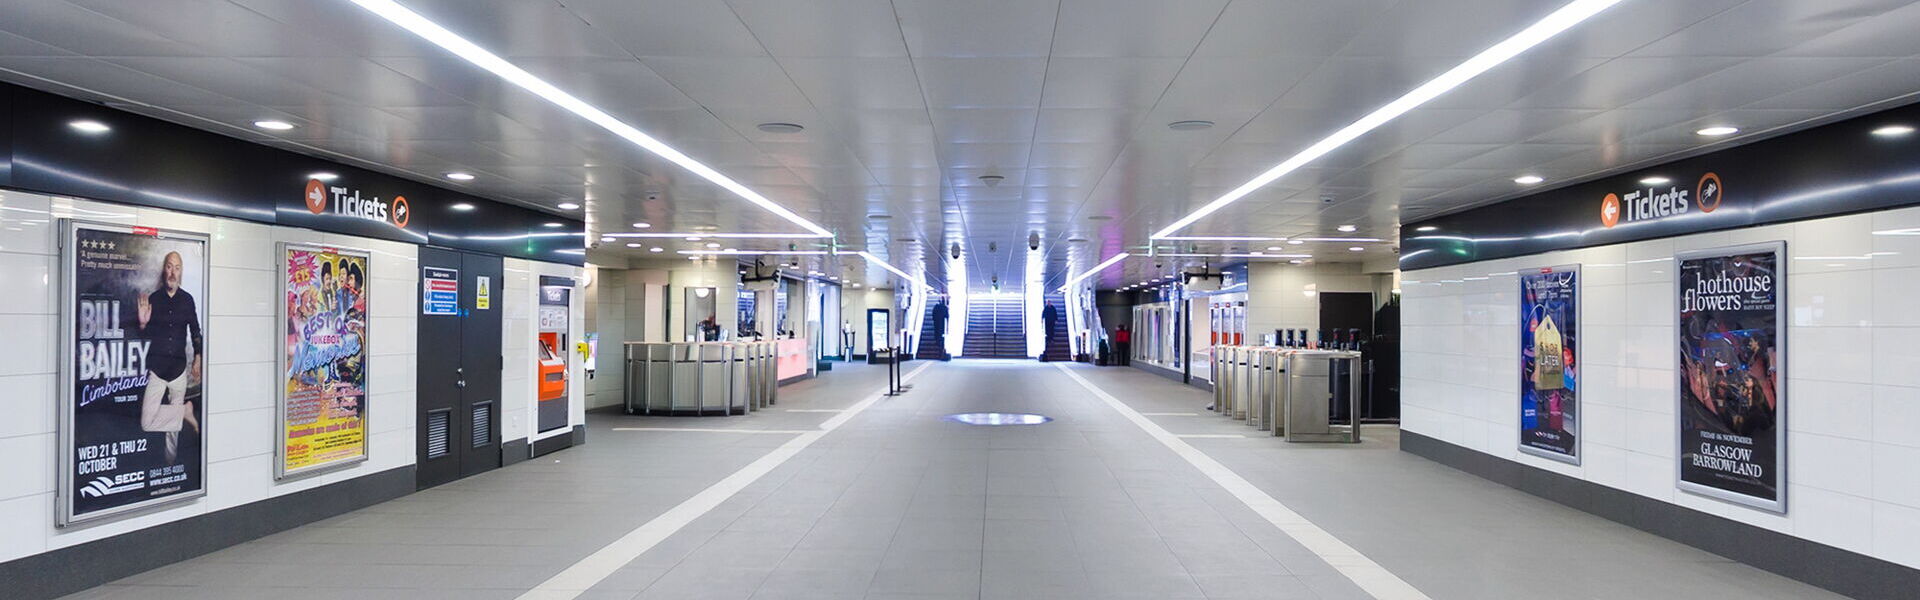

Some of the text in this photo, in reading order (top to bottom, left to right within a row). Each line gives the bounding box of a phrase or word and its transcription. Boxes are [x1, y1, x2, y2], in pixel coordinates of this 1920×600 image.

[331, 186, 387, 222] Tickets
[1624, 187, 1688, 221] Tickets
[1696, 269, 1771, 295] hothouse
[1681, 288, 1741, 313] flowers
[80, 300, 125, 339] BILL
[304, 311, 333, 341] BEST
[80, 339, 151, 380] BAILEY
[80, 370, 149, 407] Limboland
[78, 438, 148, 461] WED 21 & THU 22
[1701, 442, 1752, 462] GLASGOW
[1722, 434, 1753, 445] NOVEMBER
[78, 457, 118, 475] OCTOBER
[114, 471, 145, 485] SECC
[1693, 453, 1763, 478] BARROWLAND
